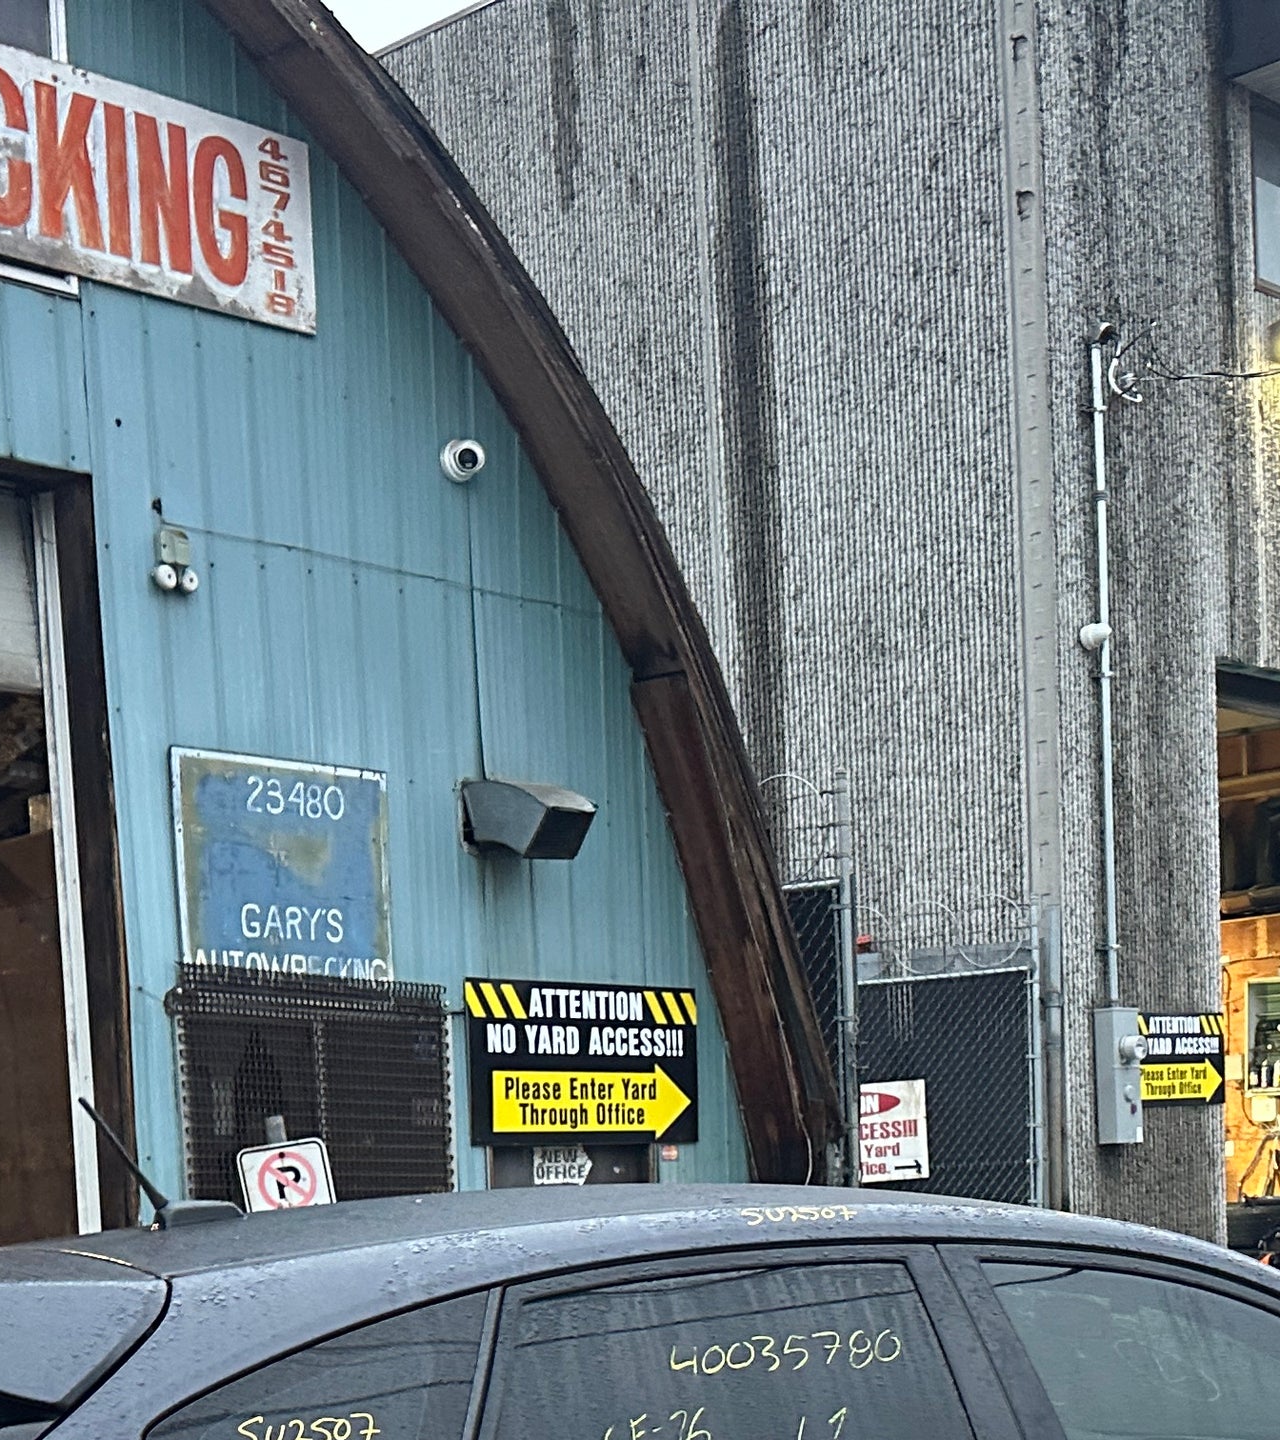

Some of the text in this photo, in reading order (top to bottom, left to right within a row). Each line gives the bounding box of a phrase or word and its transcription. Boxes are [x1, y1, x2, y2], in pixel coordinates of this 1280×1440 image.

[246, 775, 346, 821] 23480
[240, 902, 345, 943] GARY'S
[528, 987, 644, 1022] ATTENTION
[1148, 1016, 1201, 1035] ATTENTION
[486, 1022, 685, 1058] NO YARD ACCESS!!!
[1147, 1036, 1220, 1055] YARD ACCESS!!!
[1166, 1066, 1188, 1081] Enter
[1190, 1066, 1208, 1080] Yard
[504, 1076, 658, 1101] Please Enter Yard
[1145, 1081, 1202, 1098] Through Office
[518, 1102, 646, 1130] Through Office
[540, 1148, 578, 1164] NEW
[864, 1142, 901, 1159] Yard
[535, 1162, 587, 1181] OFFICE
[741, 1204, 858, 1226] SU2507
[669, 1328, 902, 1376] 40035780
